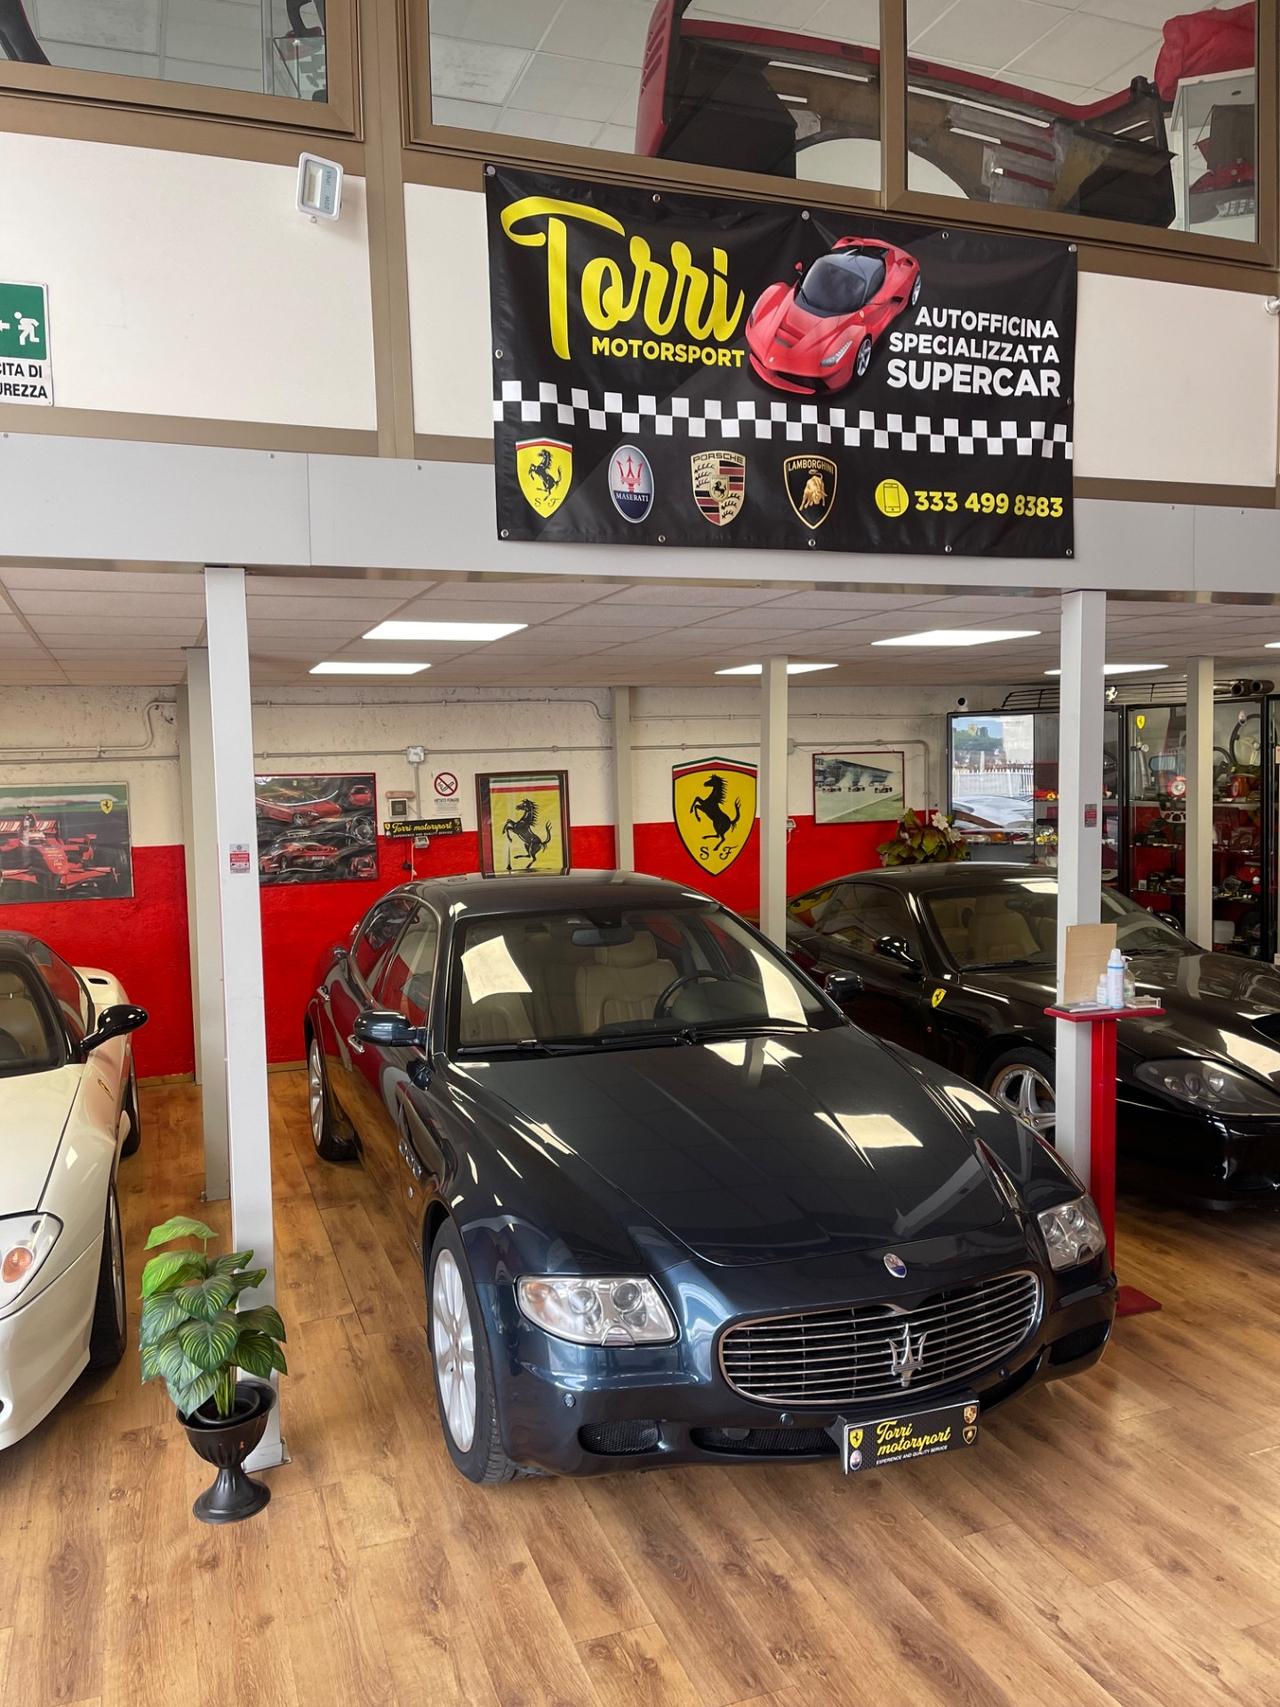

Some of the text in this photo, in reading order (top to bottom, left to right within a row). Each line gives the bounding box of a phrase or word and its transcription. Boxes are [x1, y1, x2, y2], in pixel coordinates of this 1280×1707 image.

[500, 196, 745, 360] Torri
[915, 306, 1059, 339] AUTOFFICINA
[591, 336, 745, 367] MOTORSPORT
[888, 331, 1060, 364] SPECIALIZZATA
[0, 362, 42, 378] ITA DI
[886, 358, 1061, 397] SUPERCAR
[693, 452, 744, 464] PORSCHE
[788, 459, 834, 474] LAMBORGHINI
[615, 492, 649, 503] MASERATI
[914, 490, 1064, 518] 333 499 8383
[392, 821, 452, 834] Torri motorsport
[700, 844, 738, 861] S F
[876, 1420, 912, 1444] Torri
[876, 1426, 951, 1456] motorsport
